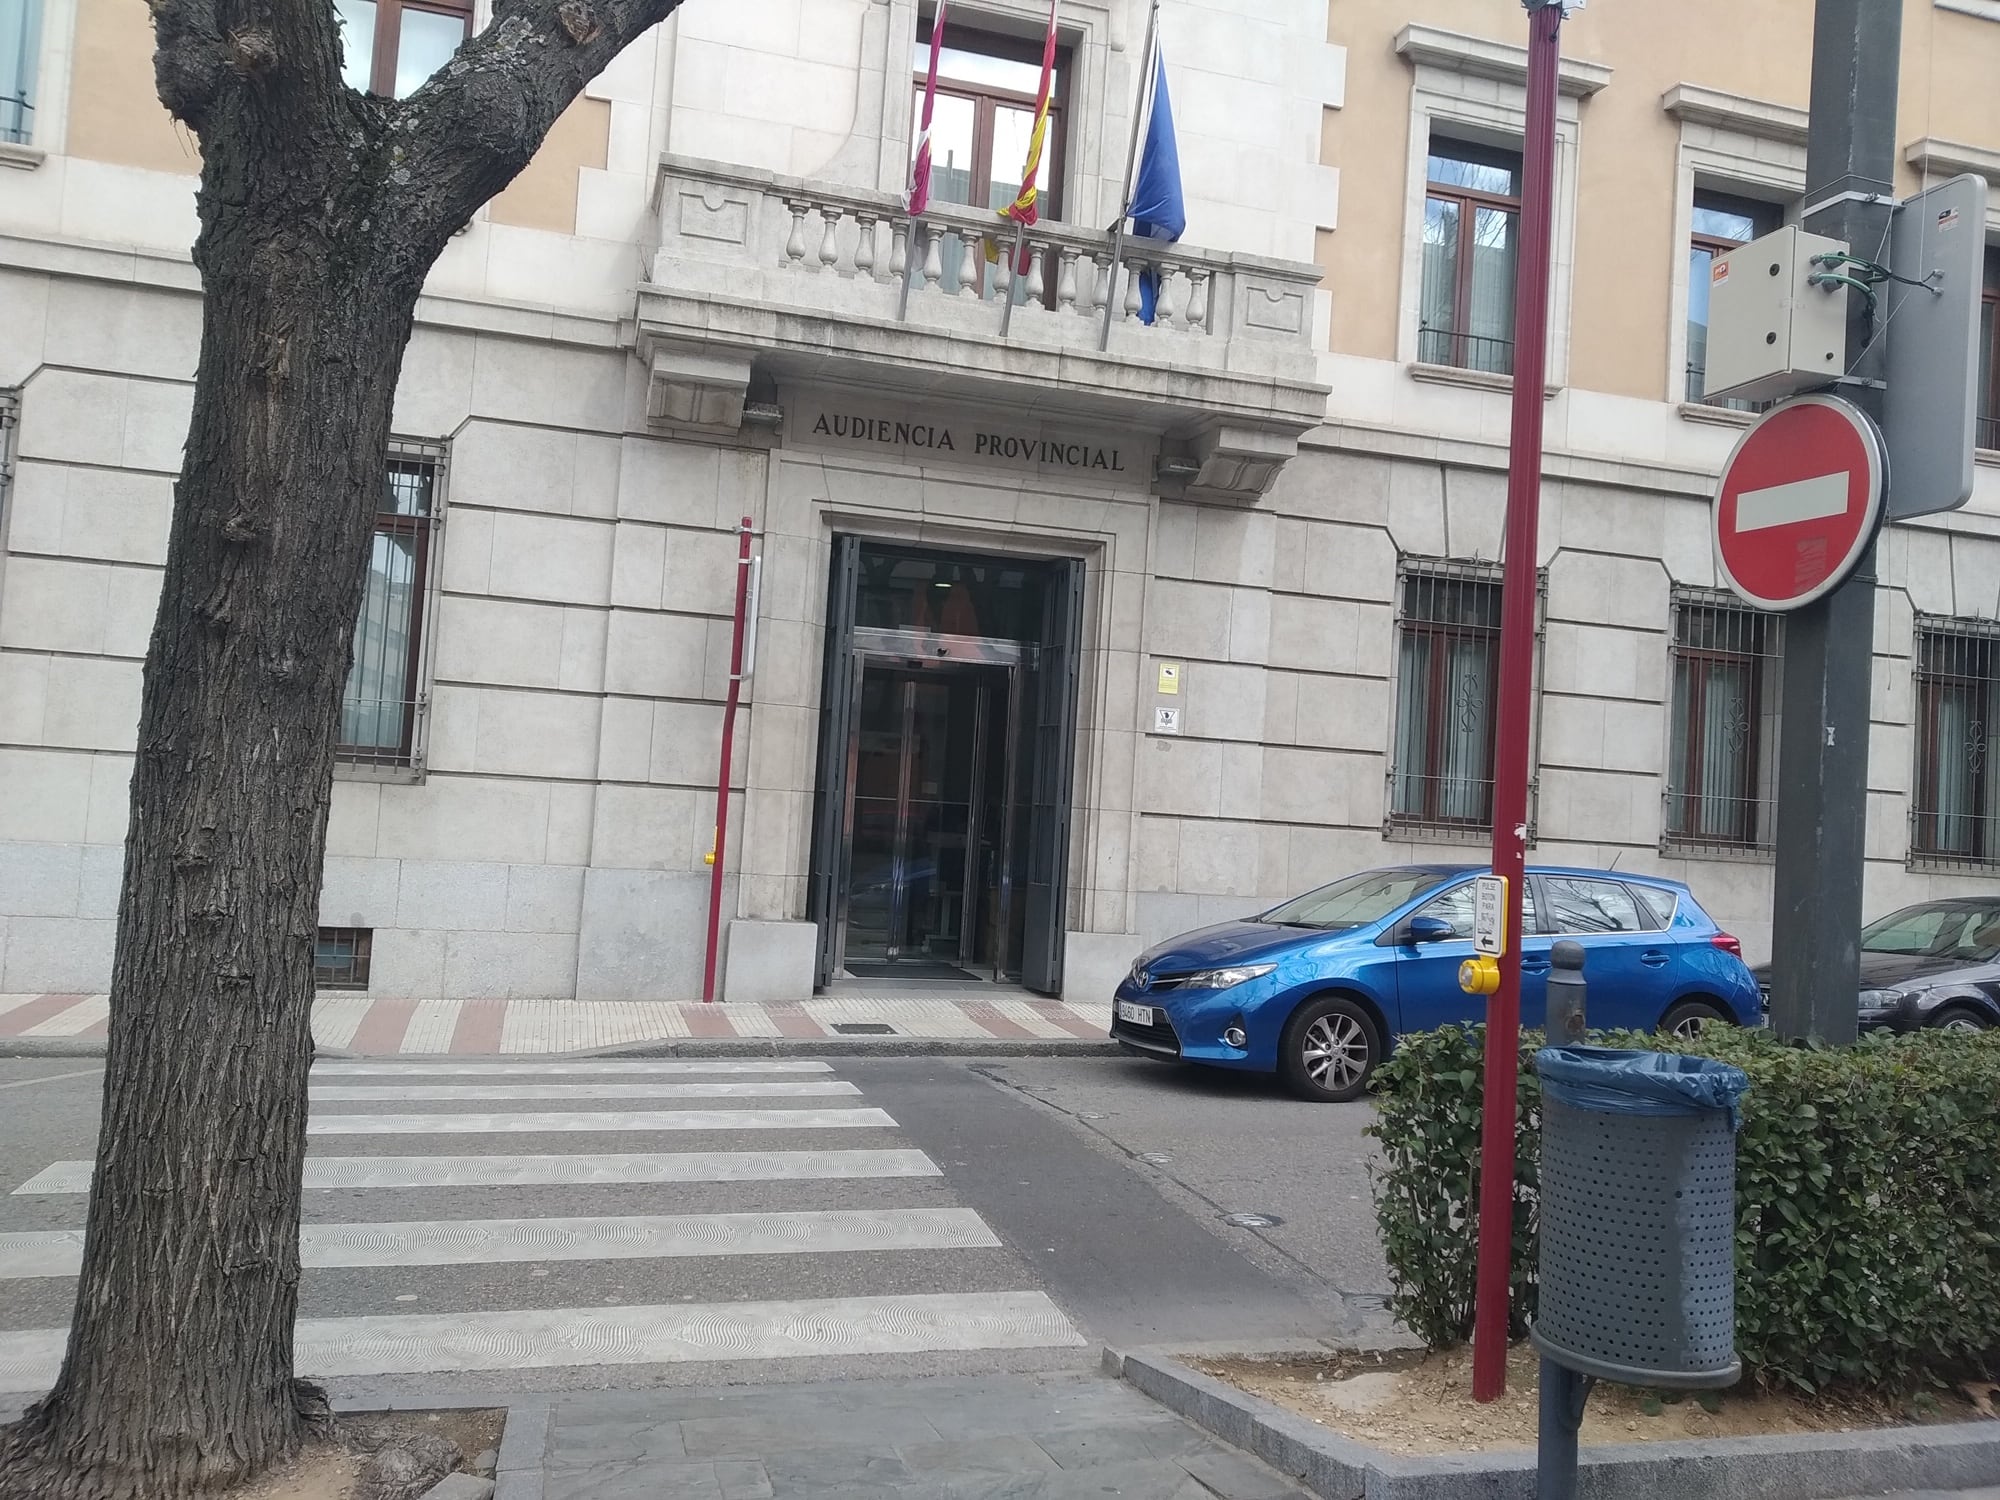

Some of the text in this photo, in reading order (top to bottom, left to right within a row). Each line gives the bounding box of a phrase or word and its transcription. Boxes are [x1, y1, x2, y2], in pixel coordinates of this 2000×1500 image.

[812, 412, 1126, 472] AUDIENCIA PROVINCIAL
[1481, 902, 1495, 910] PARA
[1137, 1008, 1151, 1024] HTN
